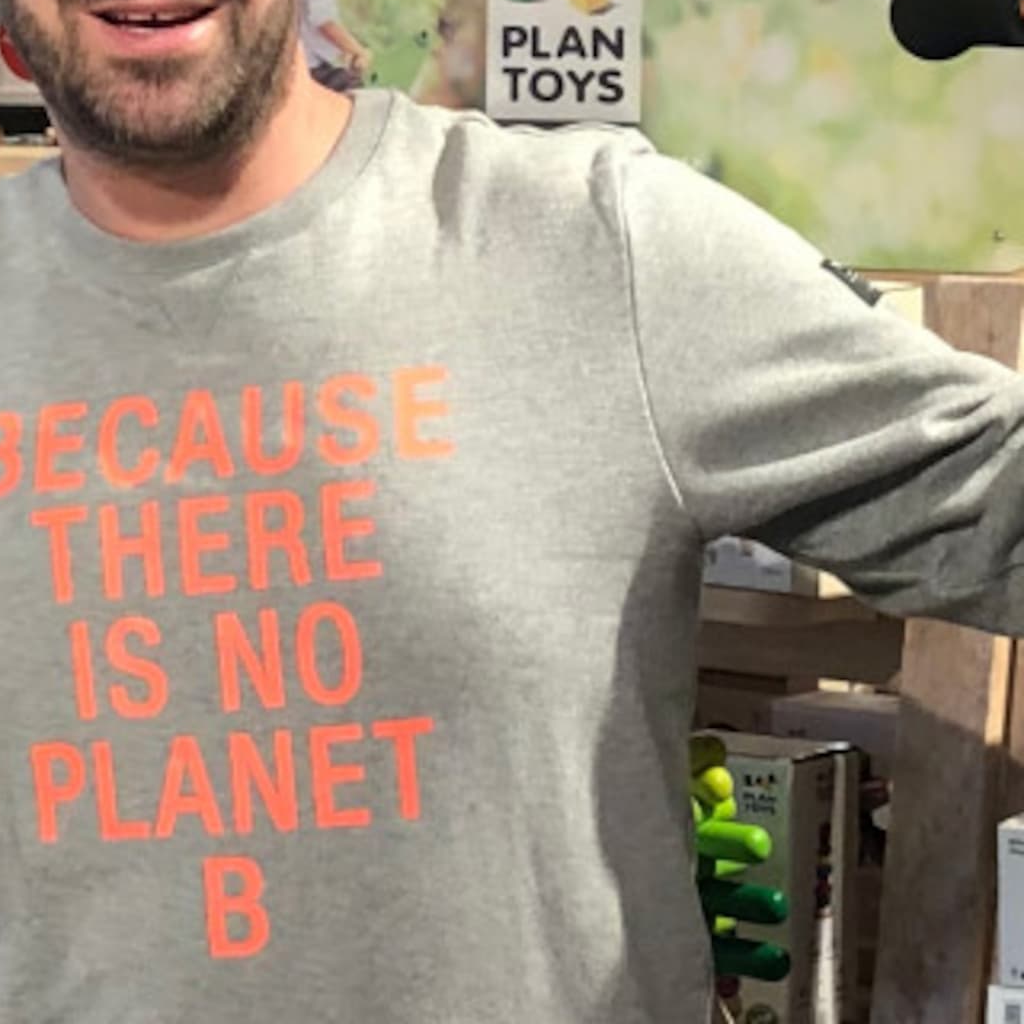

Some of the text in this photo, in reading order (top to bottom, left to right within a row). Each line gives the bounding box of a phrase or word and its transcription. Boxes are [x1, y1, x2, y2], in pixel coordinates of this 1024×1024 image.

[502, 26, 624, 60] PLAN
[502, 67, 624, 103] TOYS
[30, 480, 382, 603] THERE
[69, 601, 364, 721] IS NO
[30, 716, 435, 843] PLANET
[203, 854, 271, 960] B
